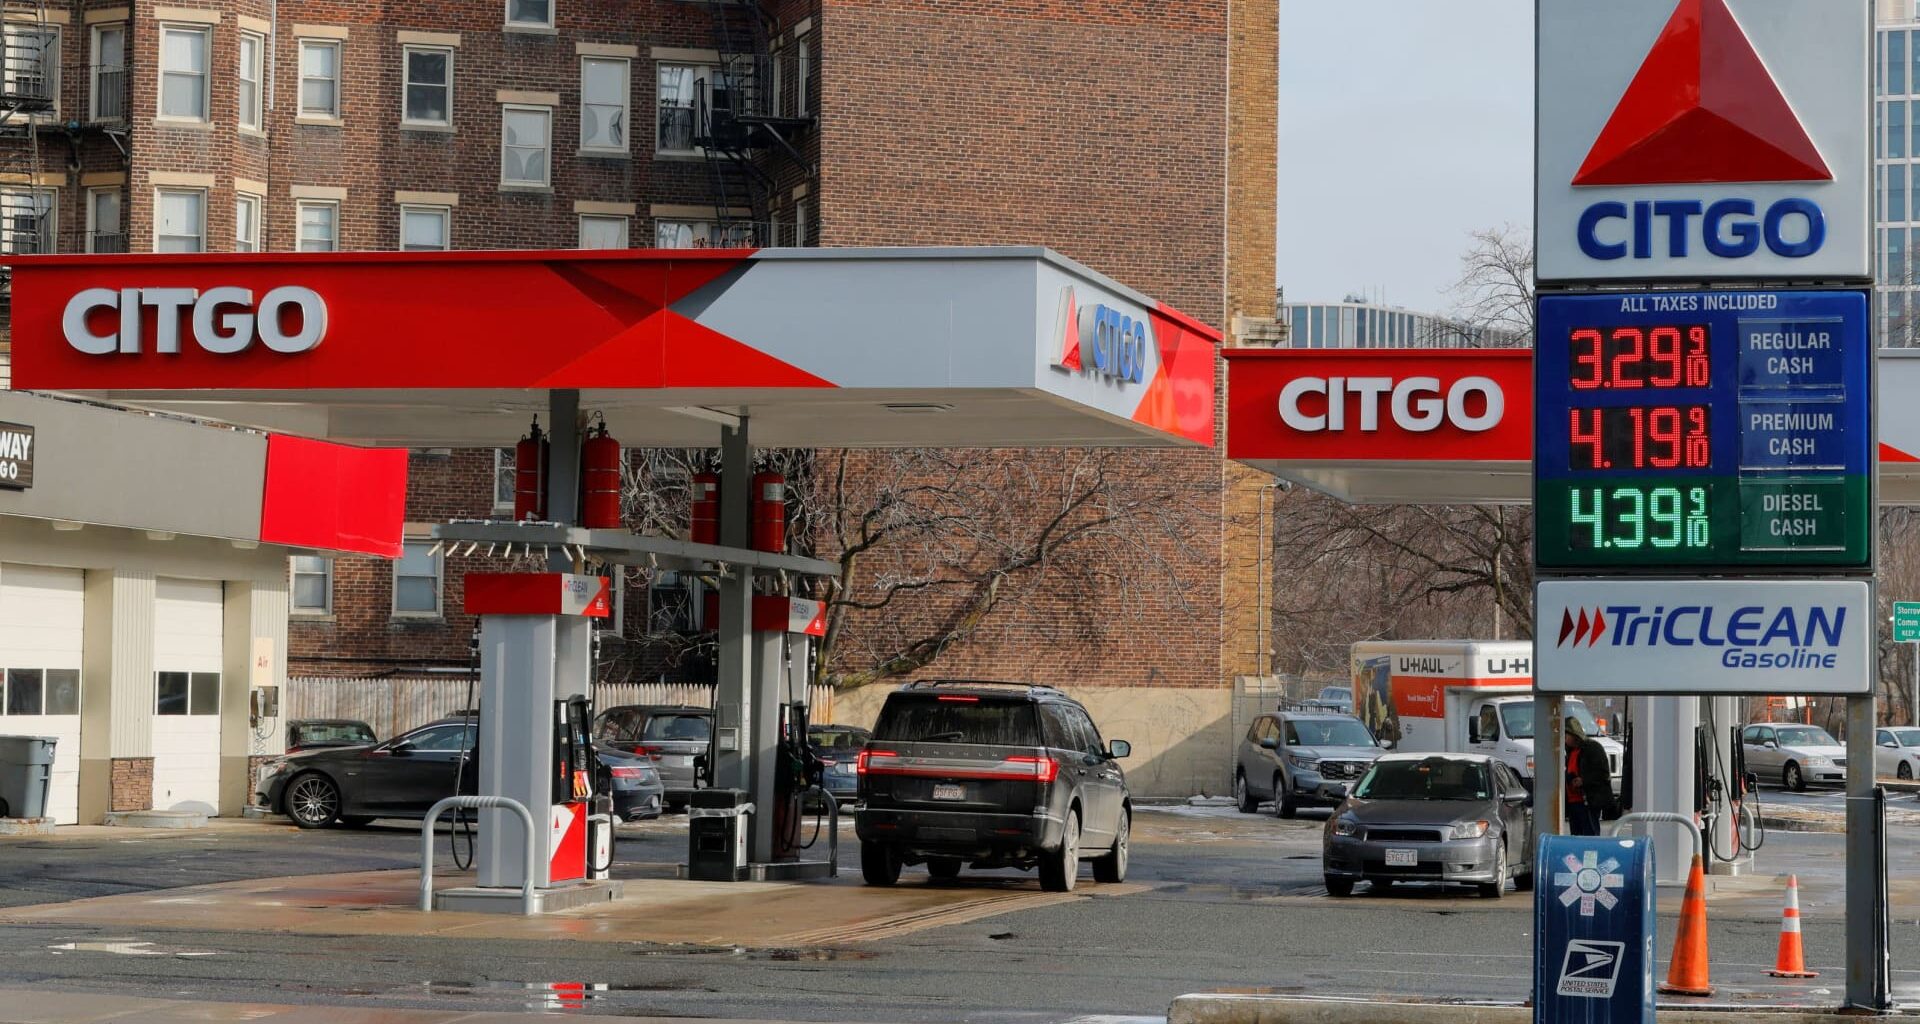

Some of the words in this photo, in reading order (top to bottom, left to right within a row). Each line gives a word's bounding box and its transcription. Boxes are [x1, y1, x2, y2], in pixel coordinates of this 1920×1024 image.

[1577, 198, 1826, 260] CITGO
[1620, 297, 1648, 312] ALL
[1652, 296, 1698, 311] TAXES
[1703, 294, 1777, 310] INCLUDED
[62, 285, 328, 354] CITGO
[1086, 303, 1146, 385] CITGO
[1750, 332, 1831, 350] REGULAR
[1571, 327, 1681, 388] 3.29
[1767, 357, 1814, 374] CASH
[1278, 376, 1505, 432] CITGO
[1751, 413, 1833, 431] PREMIUM
[1570, 408, 1681, 468] 4.19
[1769, 438, 1815, 455] CASH
[1763, 494, 1823, 512] DIESEL
[1571, 488, 1681, 548] 4.39
[1770, 518, 1817, 536] CASH
[1606, 606, 1847, 647] TriCLEAN
[1897, 618, 1919, 626] Comm
[1722, 648, 1836, 669] Gasoline
[1562, 979, 1586, 987] UNITED
[1585, 987, 1610, 995] SERVICE
